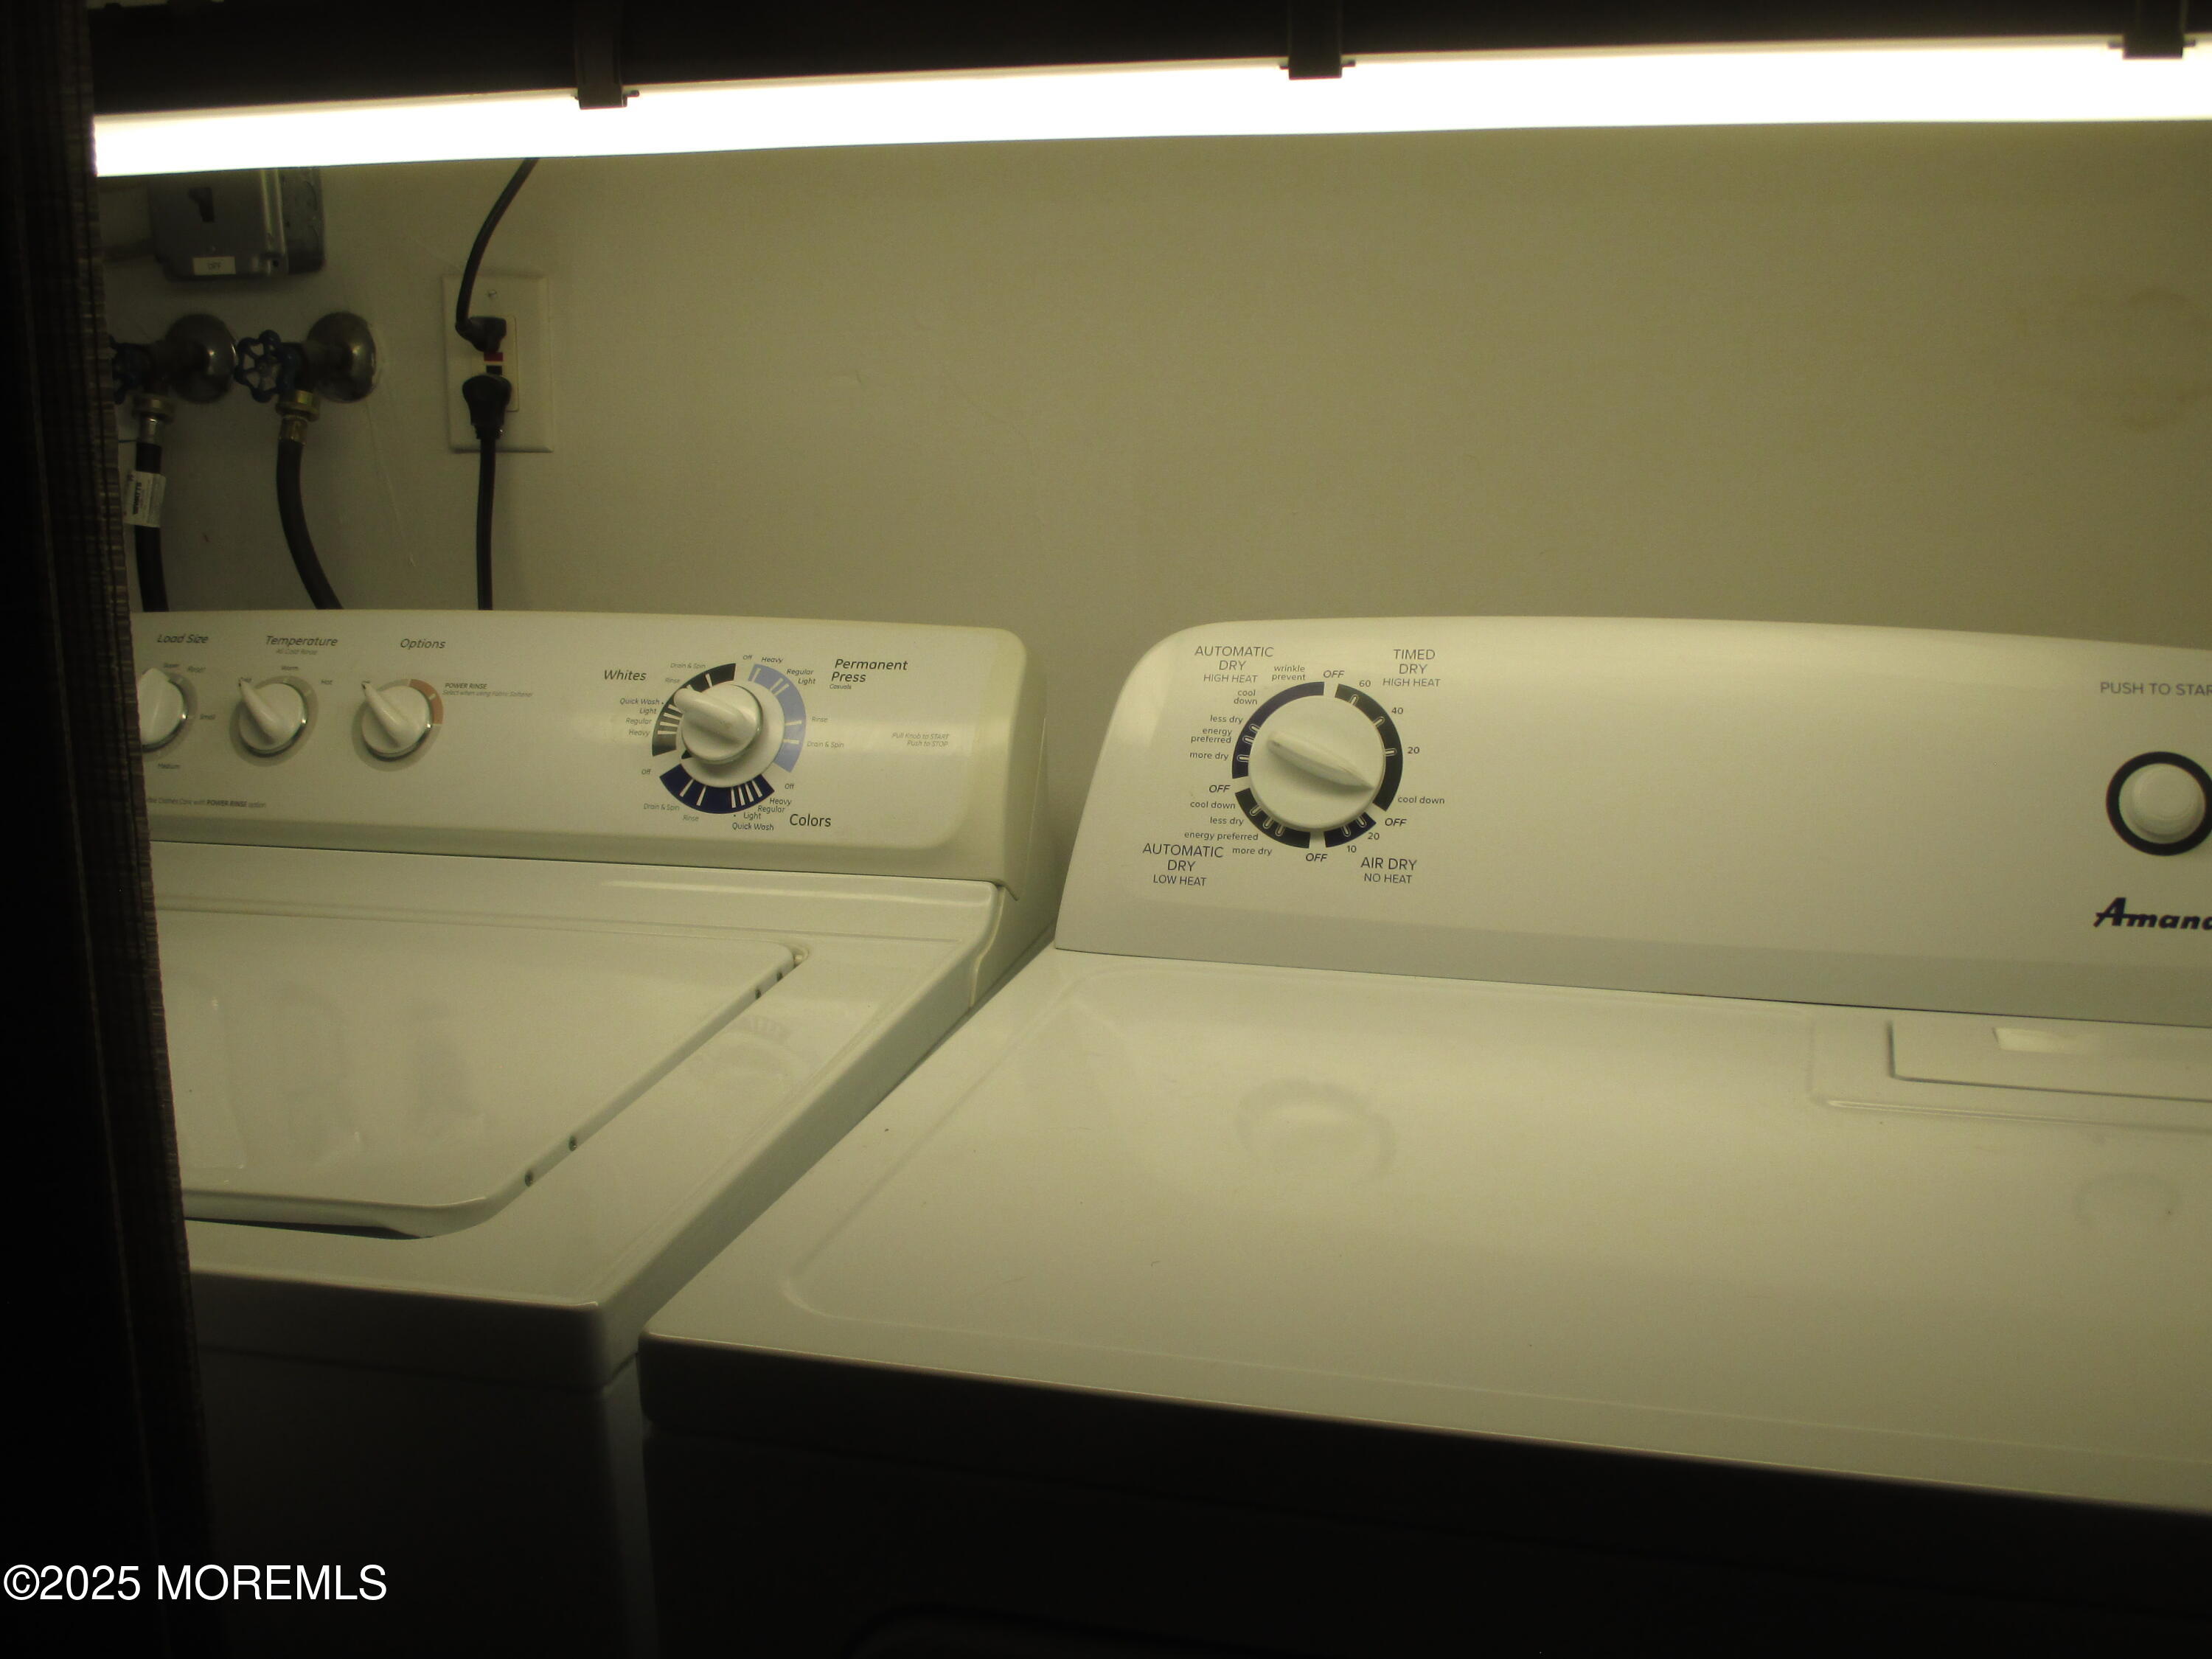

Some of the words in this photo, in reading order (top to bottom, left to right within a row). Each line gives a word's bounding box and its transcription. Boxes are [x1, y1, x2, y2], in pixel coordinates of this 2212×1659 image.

[157, 634, 184, 644] Load
[186, 634, 209, 644] Size
[265, 636, 338, 647] Temperature
[400, 638, 446, 650] Options
[1194, 646, 1275, 657] AUTOMATIC
[1394, 649, 1436, 660] TIMED
[835, 658, 908, 670] Permanent
[1219, 660, 1247, 671] DRY
[1399, 664, 1428, 674] DRY
[604, 669, 647, 681] Whites
[832, 672, 866, 683] Press
[1232, 675, 1258, 683] HEAT
[1323, 670, 1345, 678] OFF
[1382, 678, 1410, 686] HIGH
[1413, 678, 1441, 687] HEAT
[2100, 682, 2144, 694] PUSH
[2149, 683, 2171, 695] TO
[2175, 684, 2212, 696] STAR
[625, 717, 652, 726] Regular
[1229, 716, 1243, 724] dry
[1191, 736, 1231, 744] preferred
[1214, 752, 1229, 761] dry
[1209, 785, 1231, 793] OFF
[770, 798, 792, 806] Heavy
[789, 814, 832, 827] Colors
[1230, 817, 1244, 826] dry
[1385, 818, 1407, 827] OFF
[1184, 832, 1215, 841] energy
[1217, 833, 1259, 841] preferred
[1143, 844, 1224, 858] AUTOMATIC
[1258, 848, 1273, 856] dry
[1306, 853, 1328, 862] OFF
[1167, 860, 1196, 872] DRY
[1360, 857, 1384, 869] AIR
[1388, 858, 1417, 871] DRY
[1153, 874, 1177, 884] LOW
[1180, 876, 1207, 886] HEAT
[1364, 873, 1380, 882] NO
[1384, 874, 1412, 883] HEAT
